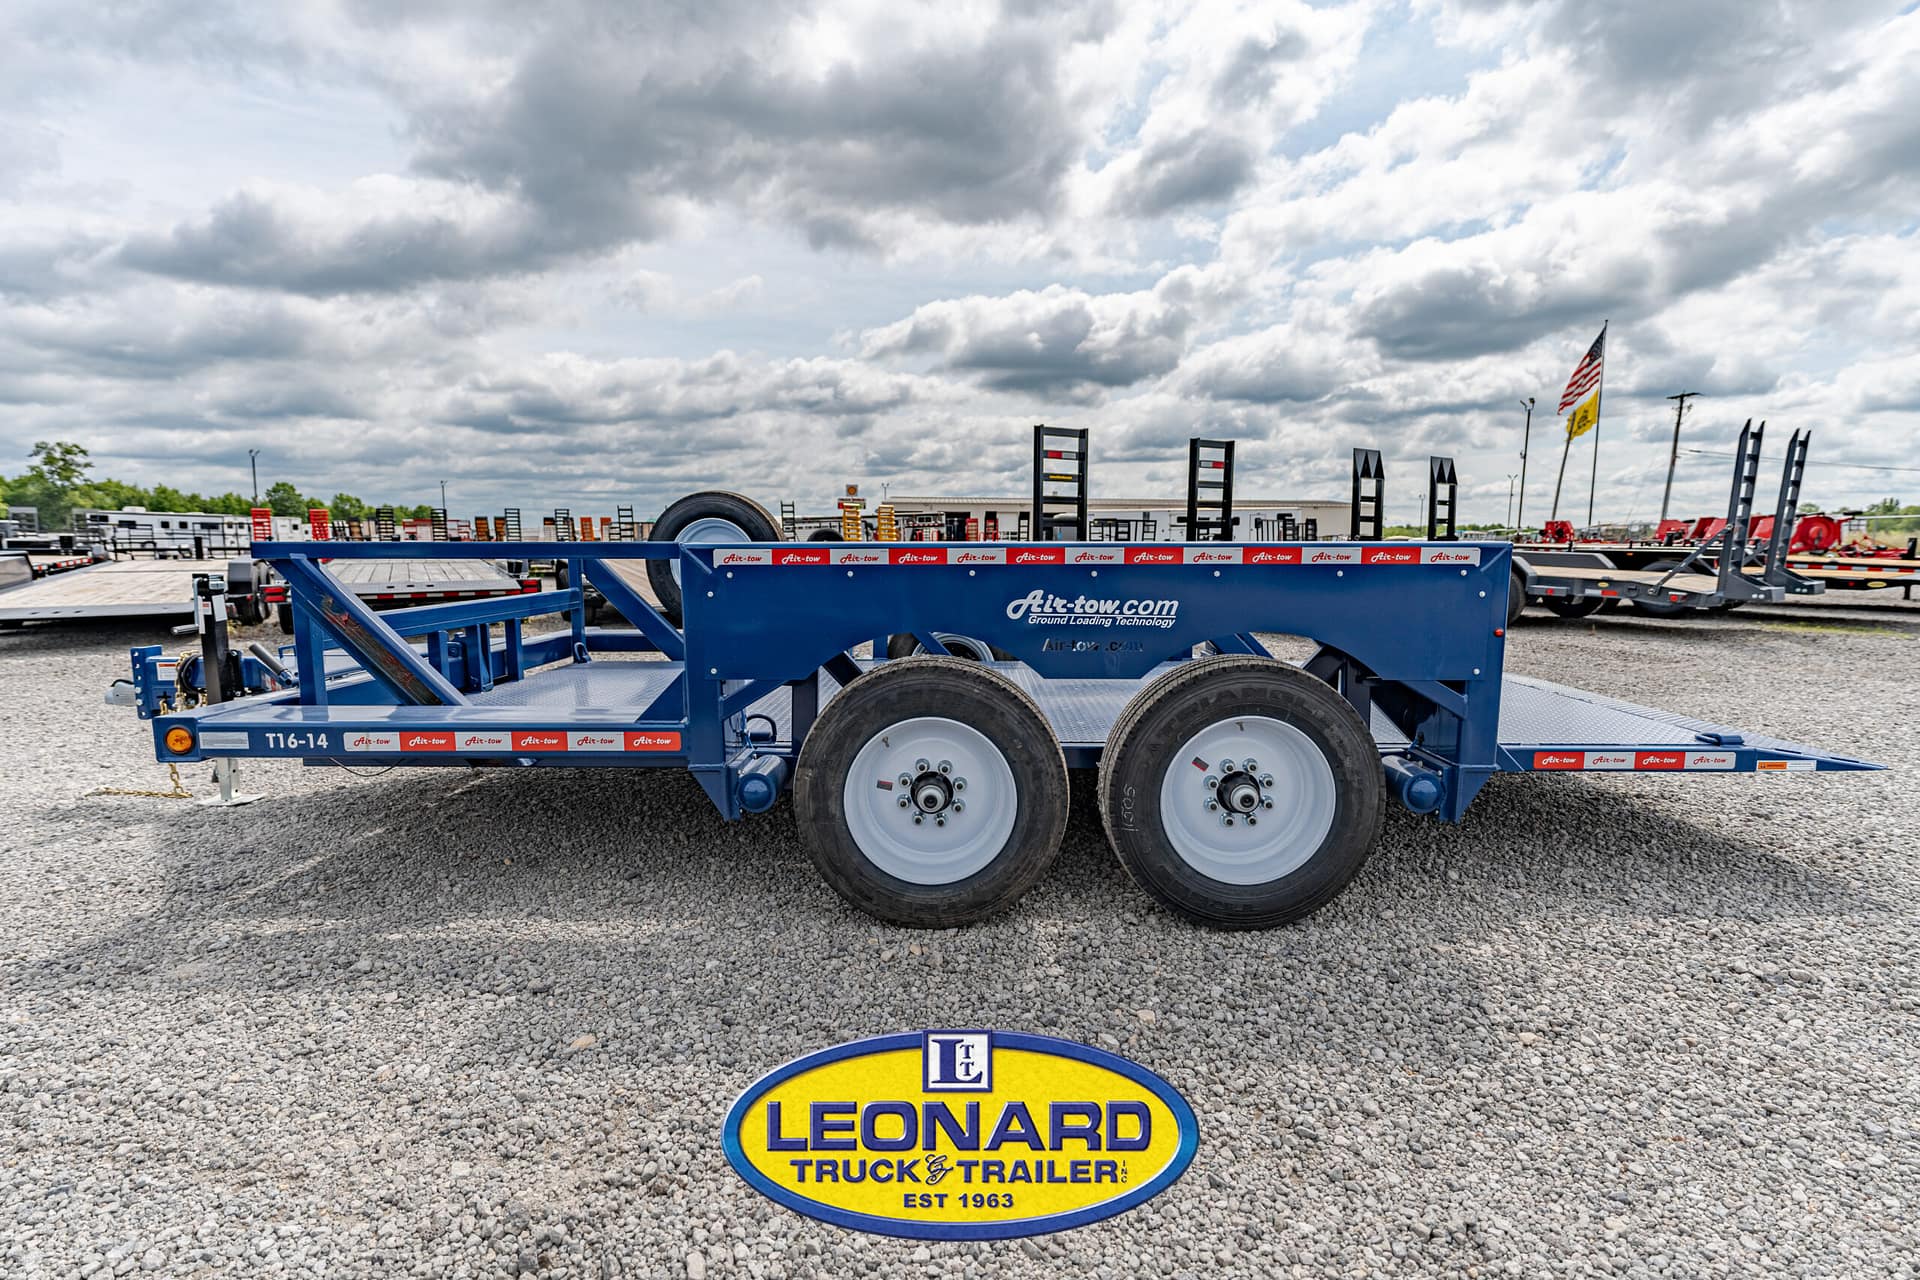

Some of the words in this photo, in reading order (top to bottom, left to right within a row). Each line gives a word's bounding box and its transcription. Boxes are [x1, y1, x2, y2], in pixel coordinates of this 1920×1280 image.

[723, 552, 763, 564] Air-tow
[781, 552, 821, 564] Air-tow
[840, 553, 879, 564] Air-tow
[898, 553, 938, 563] Air-tow
[957, 552, 997, 563] Air-tow
[1016, 552, 1056, 563] Air-tow
[1074, 552, 1115, 562] Air-tow
[1133, 552, 1174, 563] Air-tow
[1193, 552, 1233, 562] Air-tow
[1252, 552, 1293, 562] Air-tow
[1311, 552, 1352, 562] Air-tow
[1370, 552, 1412, 563] Air-tow
[1430, 552, 1471, 562] Air-tow
[1006, 589, 1179, 620] Air-tow.com
[1028, 615, 1067, 625] Ground
[1069, 616, 1112, 628] Loading
[1115, 617, 1176, 629] Technology
[265, 733, 329, 749] T16-14
[353, 735, 391, 747] Air-tow
[408, 736, 447, 747] Air-tow
[464, 736, 503, 746] Air-tow
[520, 736, 559, 746] Air-tow
[576, 736, 615, 746] Air-tow
[633, 736, 672, 747] Air-tow
[1542, 754, 1577, 765] Air-tow
[1592, 754, 1627, 765] Air-tow
[1642, 754, 1678, 765] Air-tow
[1693, 754, 1727, 764] Air-tow
